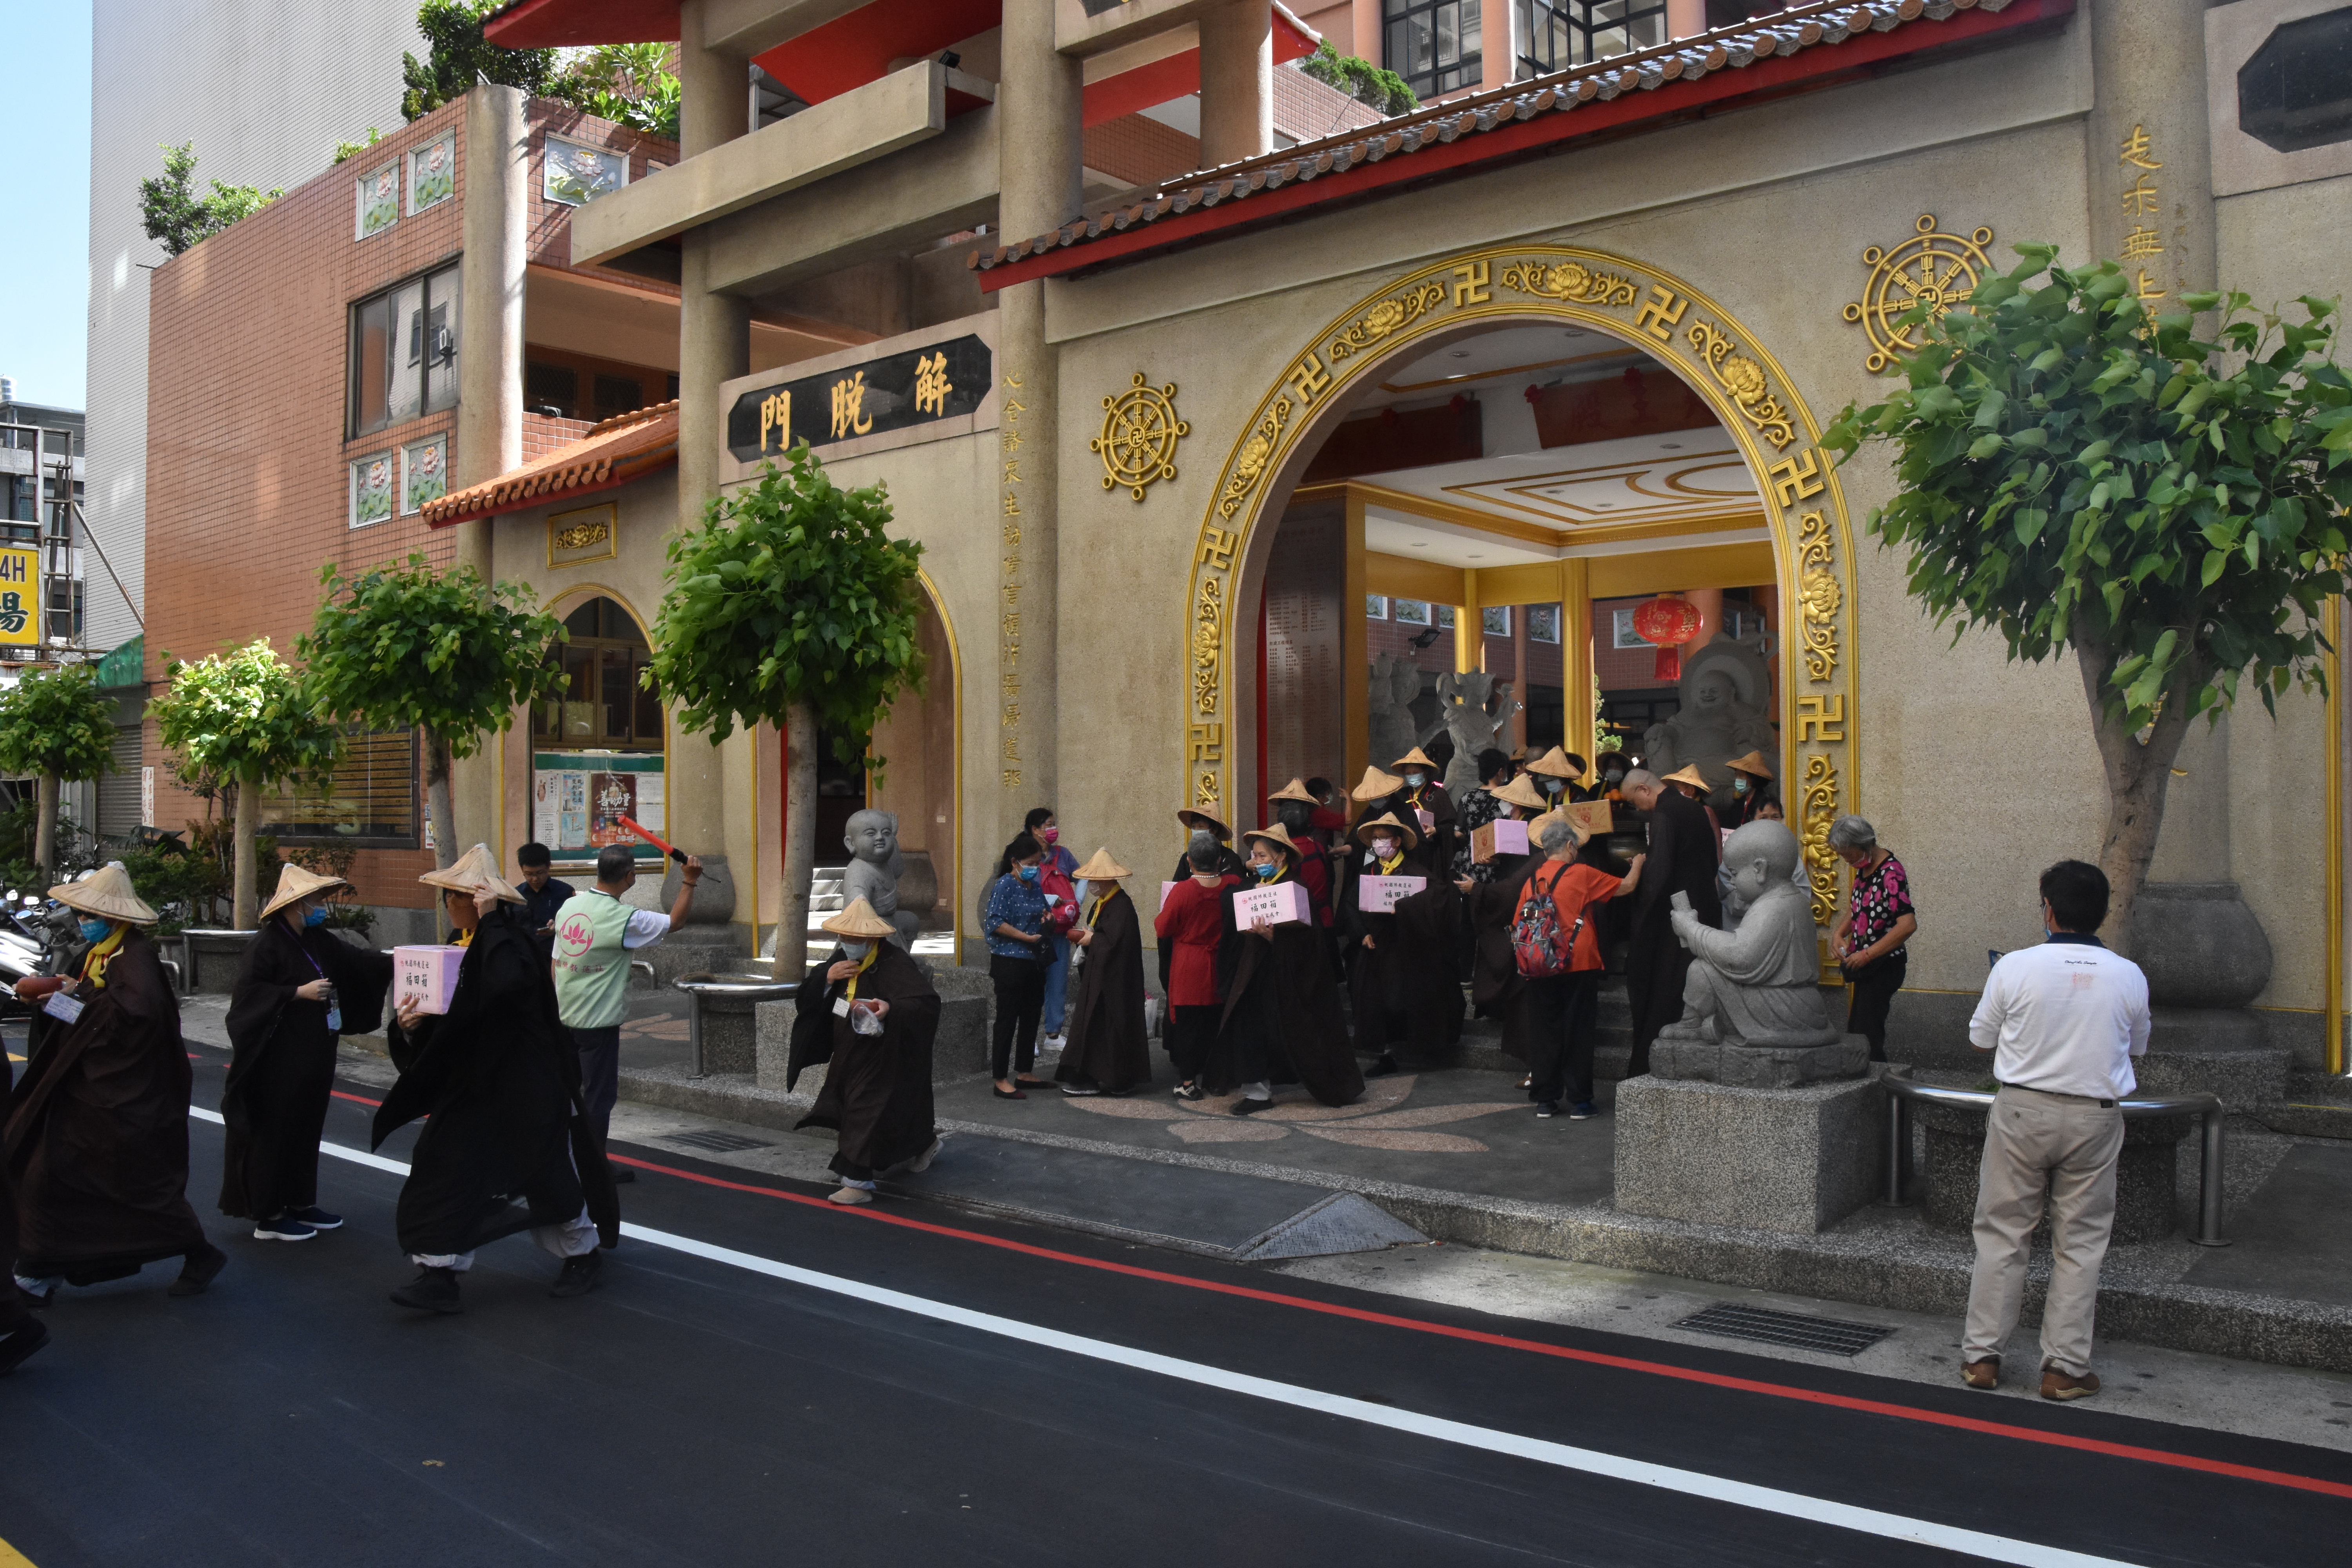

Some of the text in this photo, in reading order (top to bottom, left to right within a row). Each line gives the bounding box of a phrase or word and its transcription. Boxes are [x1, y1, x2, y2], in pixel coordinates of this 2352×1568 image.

[597, 789, 631, 807] 善的力量
[1248, 891, 1278, 901] 桃園佛教蓮社
[1385, 890, 1410, 898] 福田箱
[1250, 899, 1277, 913] 福田箱
[406, 972, 428, 987] 福田箱
